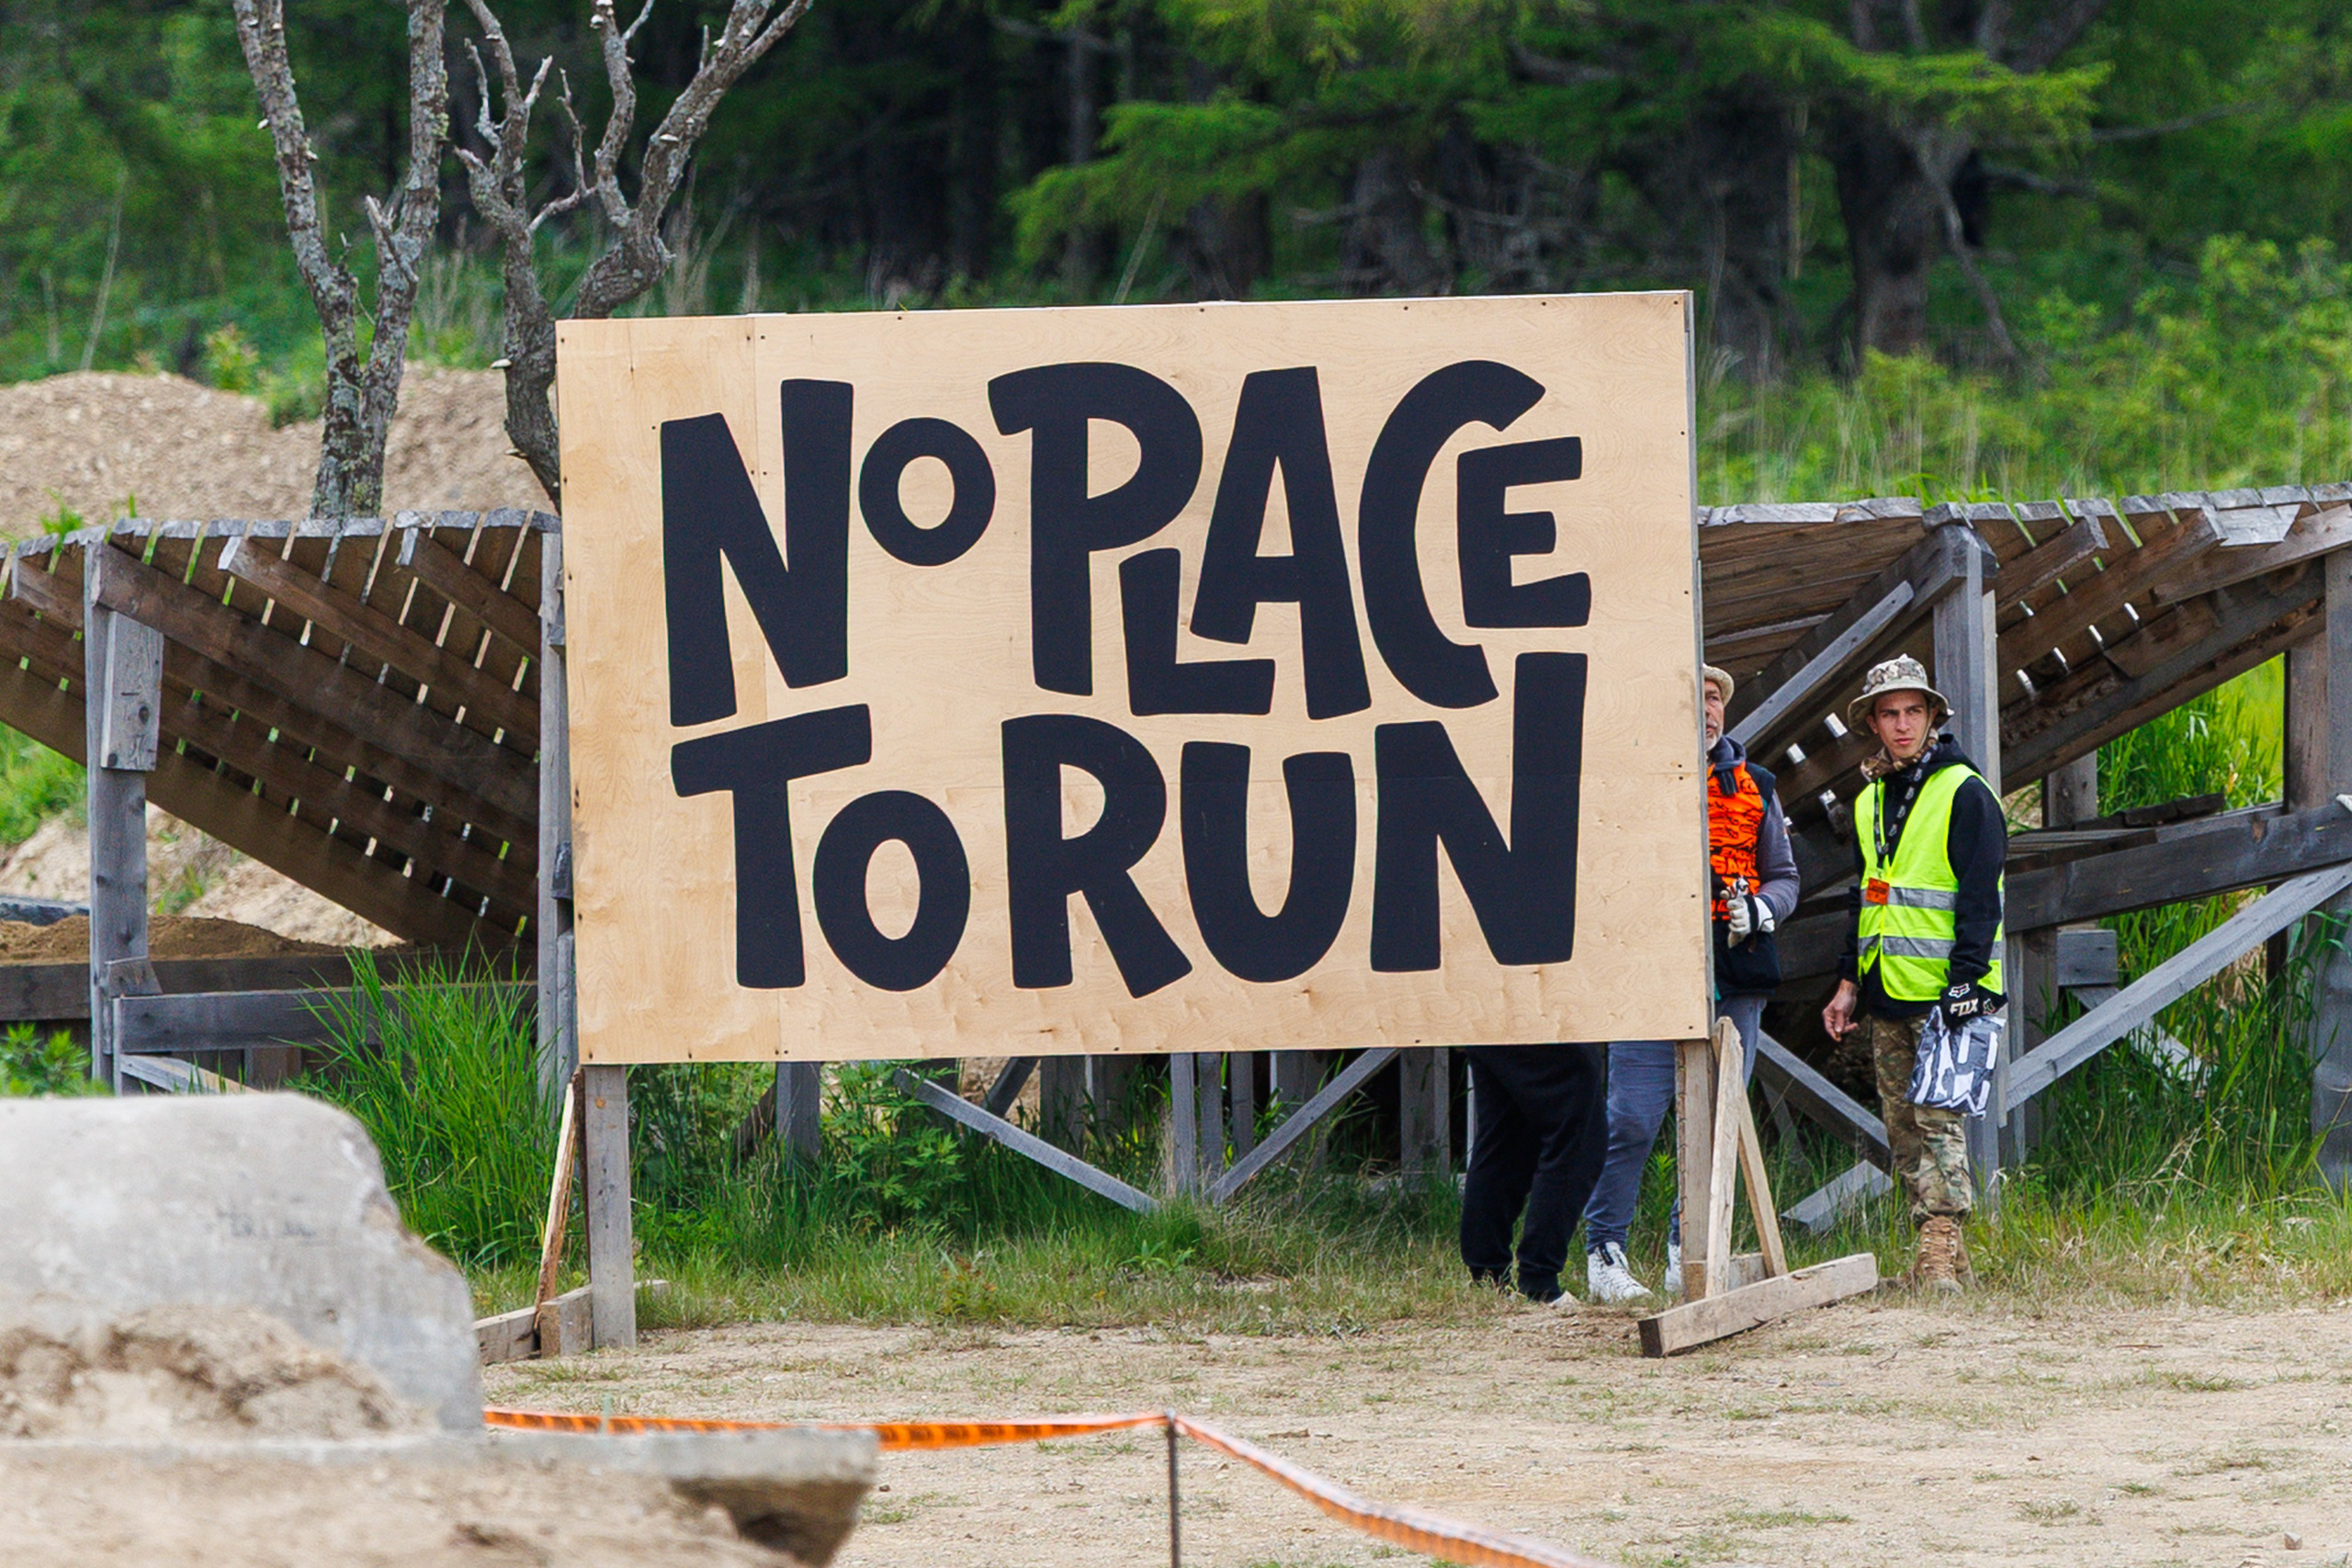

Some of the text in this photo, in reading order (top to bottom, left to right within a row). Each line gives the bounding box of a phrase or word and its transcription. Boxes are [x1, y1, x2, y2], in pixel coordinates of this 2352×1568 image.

[660, 360, 1592, 728] NO PLACE
[671, 651, 1588, 999] TO RUN
[1950, 998, 1979, 1017] FOX
